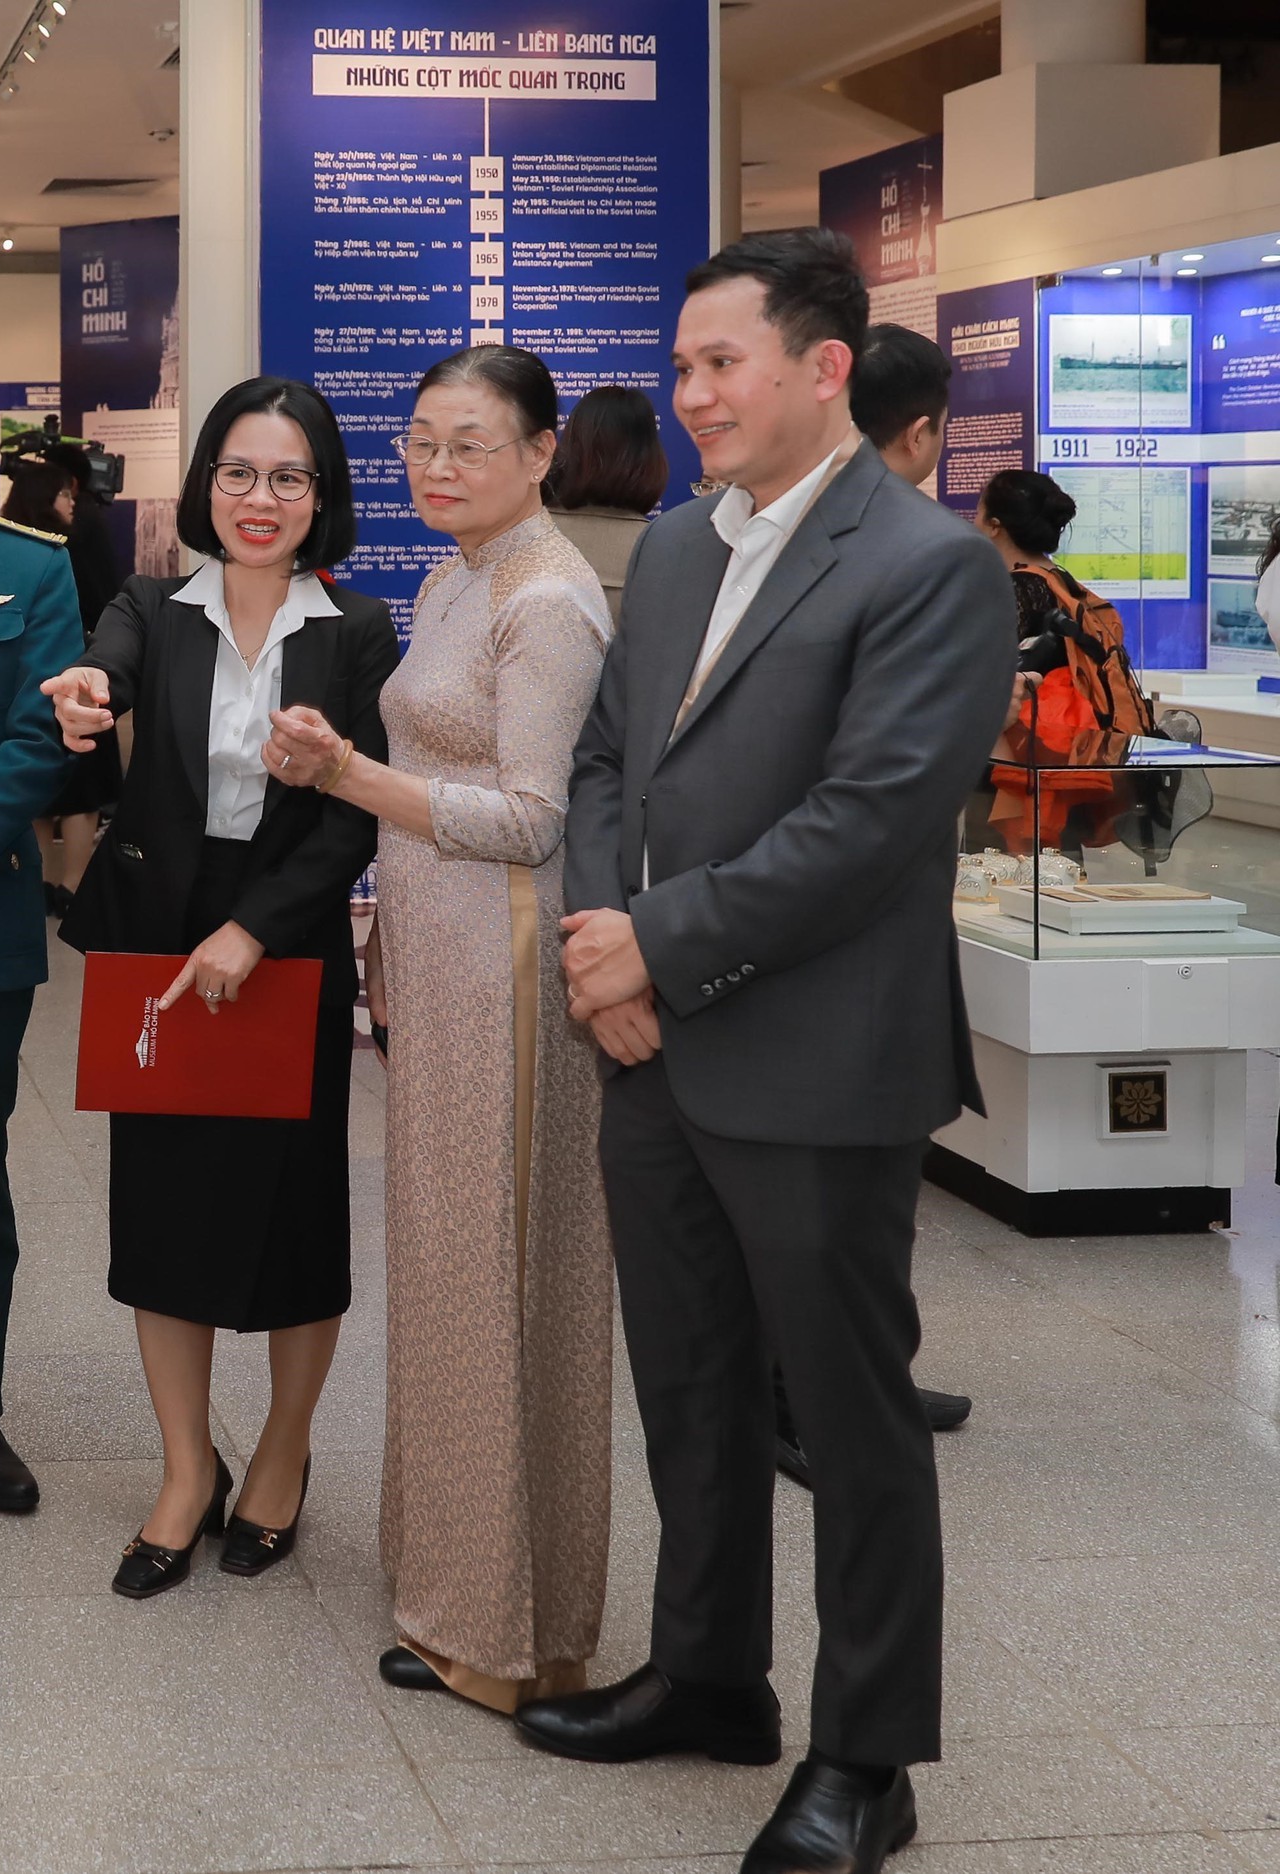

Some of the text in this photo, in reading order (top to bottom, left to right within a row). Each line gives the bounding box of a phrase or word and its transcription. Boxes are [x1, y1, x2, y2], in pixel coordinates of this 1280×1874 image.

[314, 28, 364, 50] QUAN
[370, 28, 395, 52] HỆ
[402, 28, 444, 53] VIỆT
[450, 32, 495, 51] NAM
[518, 30, 558, 52] LIÊN
[564, 33, 612, 53] BANG
[620, 35, 655, 53] NGA
[346, 63, 625, 95] NHỮNG CỘT MỐC QUAN TRỌNG
[512, 154, 543, 163] January
[544, 154, 555, 162] 30,
[556, 154, 574, 162] 1950:
[512, 162, 534, 170] Union
[476, 168, 498, 178] 1950
[512, 176, 529, 185] May
[551, 184, 574, 192] Soviet
[575, 184, 614, 192] Friendship
[512, 198, 528, 208] July
[530, 198, 549, 208] 1955:
[551, 198, 584, 208] President
[476, 210, 498, 221] 1955
[512, 241, 546, 251] February
[548, 241, 567, 249] 1965:
[512, 250, 534, 260] Union
[535, 250, 560, 260] signed
[881, 238, 913, 266] MINH
[476, 254, 498, 264] 1965
[552, 260, 592, 268] Agreement
[476, 297, 498, 307] 1978
[512, 293, 534, 303] Union
[534, 293, 559, 303] signed
[574, 294, 597, 302] Treaty
[597, 293, 606, 301] of
[512, 302, 558, 310] Cooperation
[82, 311, 127, 333] MINH
[553, 328, 564, 336] 27,
[620, 329, 659, 337] recognized
[512, 336, 525, 344] the
[526, 336, 555, 344] Russian
[532, 345, 540, 353] of
[554, 345, 576, 353] Soviet
[1052, 439, 1088, 457] 1911
[1115, 439, 1158, 457] 1922
[142, 996, 152, 1028] BẢO TÀNG
[150, 1027, 157, 1038] HỒ
